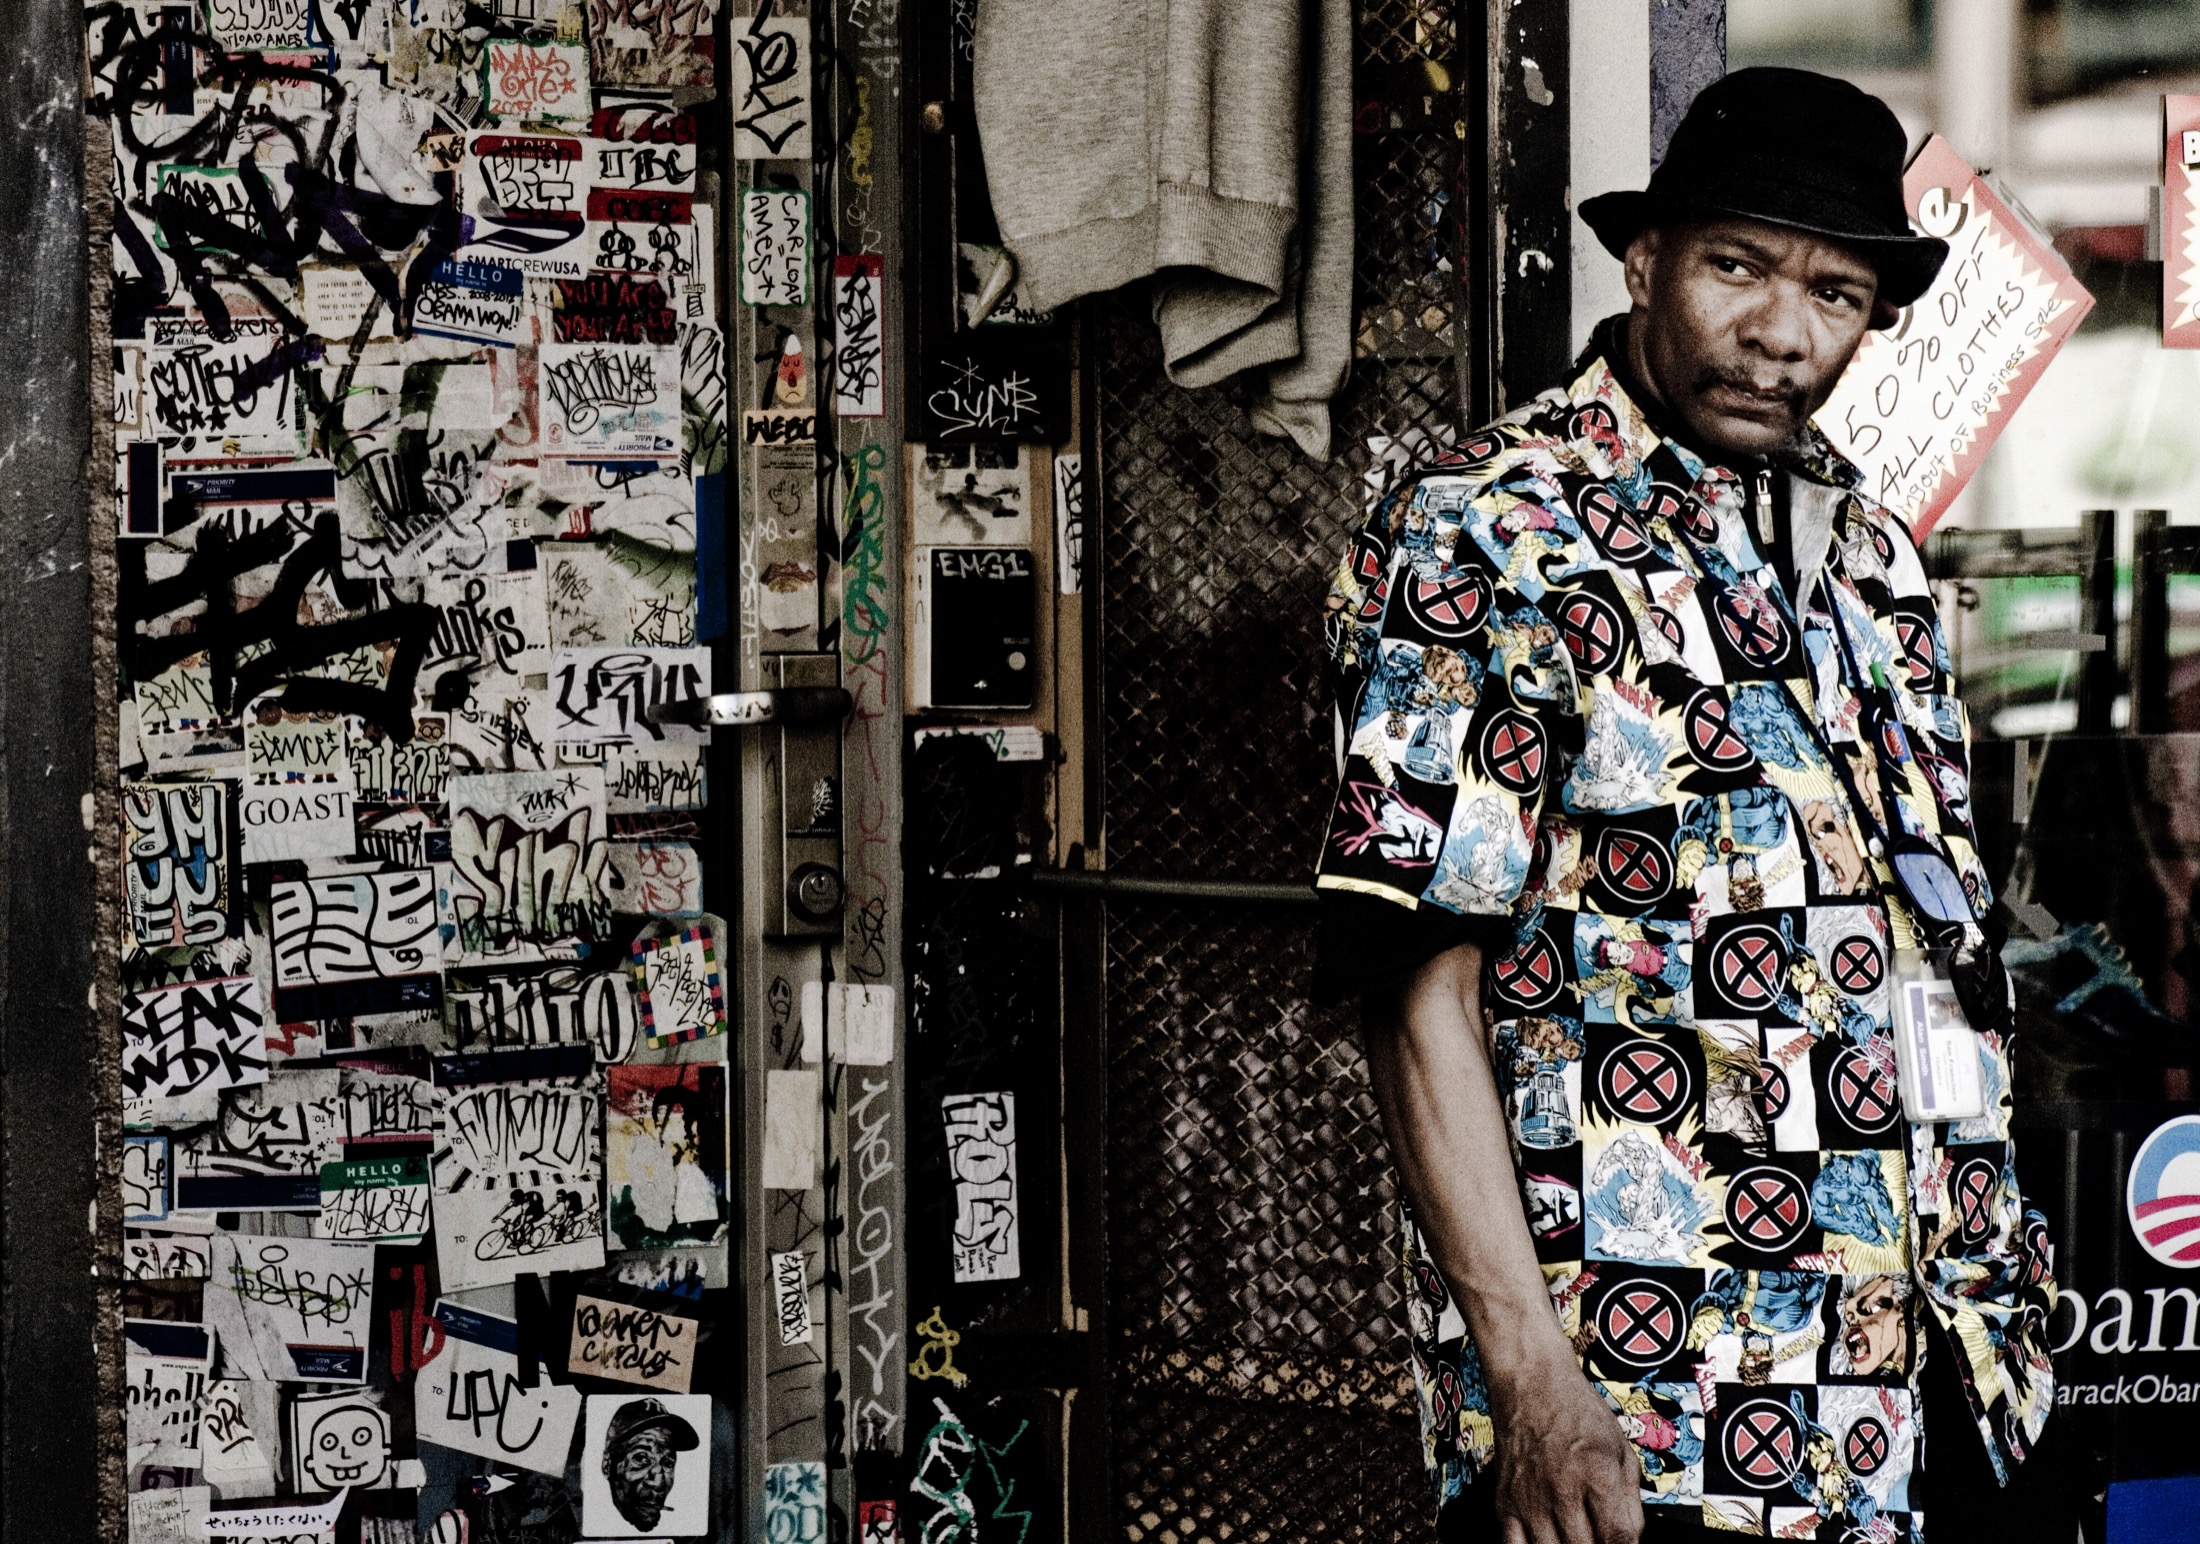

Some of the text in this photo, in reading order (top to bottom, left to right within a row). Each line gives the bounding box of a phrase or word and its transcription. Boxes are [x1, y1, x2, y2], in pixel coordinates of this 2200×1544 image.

[442, 262, 502, 283] HELLO
[466, 254, 581, 276] SMARTCREWUSA
[1938, 225, 1989, 328] OFF
[417, 297, 475, 326] OBAMA
[1950, 424, 1972, 452] OF
[1971, 344, 2026, 417] Business
[2025, 298, 2064, 341] Sale
[1879, 434, 1934, 503] ALL
[1932, 280, 2026, 421] CLOTHES
[617, 443, 652, 452] PRIORITY
[633, 434, 653, 443] MAIL
[205, 487, 222, 495] MAIL
[206, 478, 236, 486] PRIORITY
[244, 791, 351, 827] GOAST
[405, 916, 419, 925] TO:
[1770, 1032, 1818, 1070] X-MEN
[1915, 1020, 1929, 1077] Alan Smith
[312, 1114, 325, 1123] TO:
[451, 1136, 466, 1146] TO:
[346, 1165, 402, 1178] HELLO
[454, 1235, 469, 1244] TO:
[1789, 1248, 1850, 1273] X-MEN
[1554, 1270, 1600, 1310] X-MEN
[299, 1365, 330, 1373] PRIORITY
[431, 1385, 445, 1397] TO:
[1692, 1355, 1718, 1420] X-MEN
